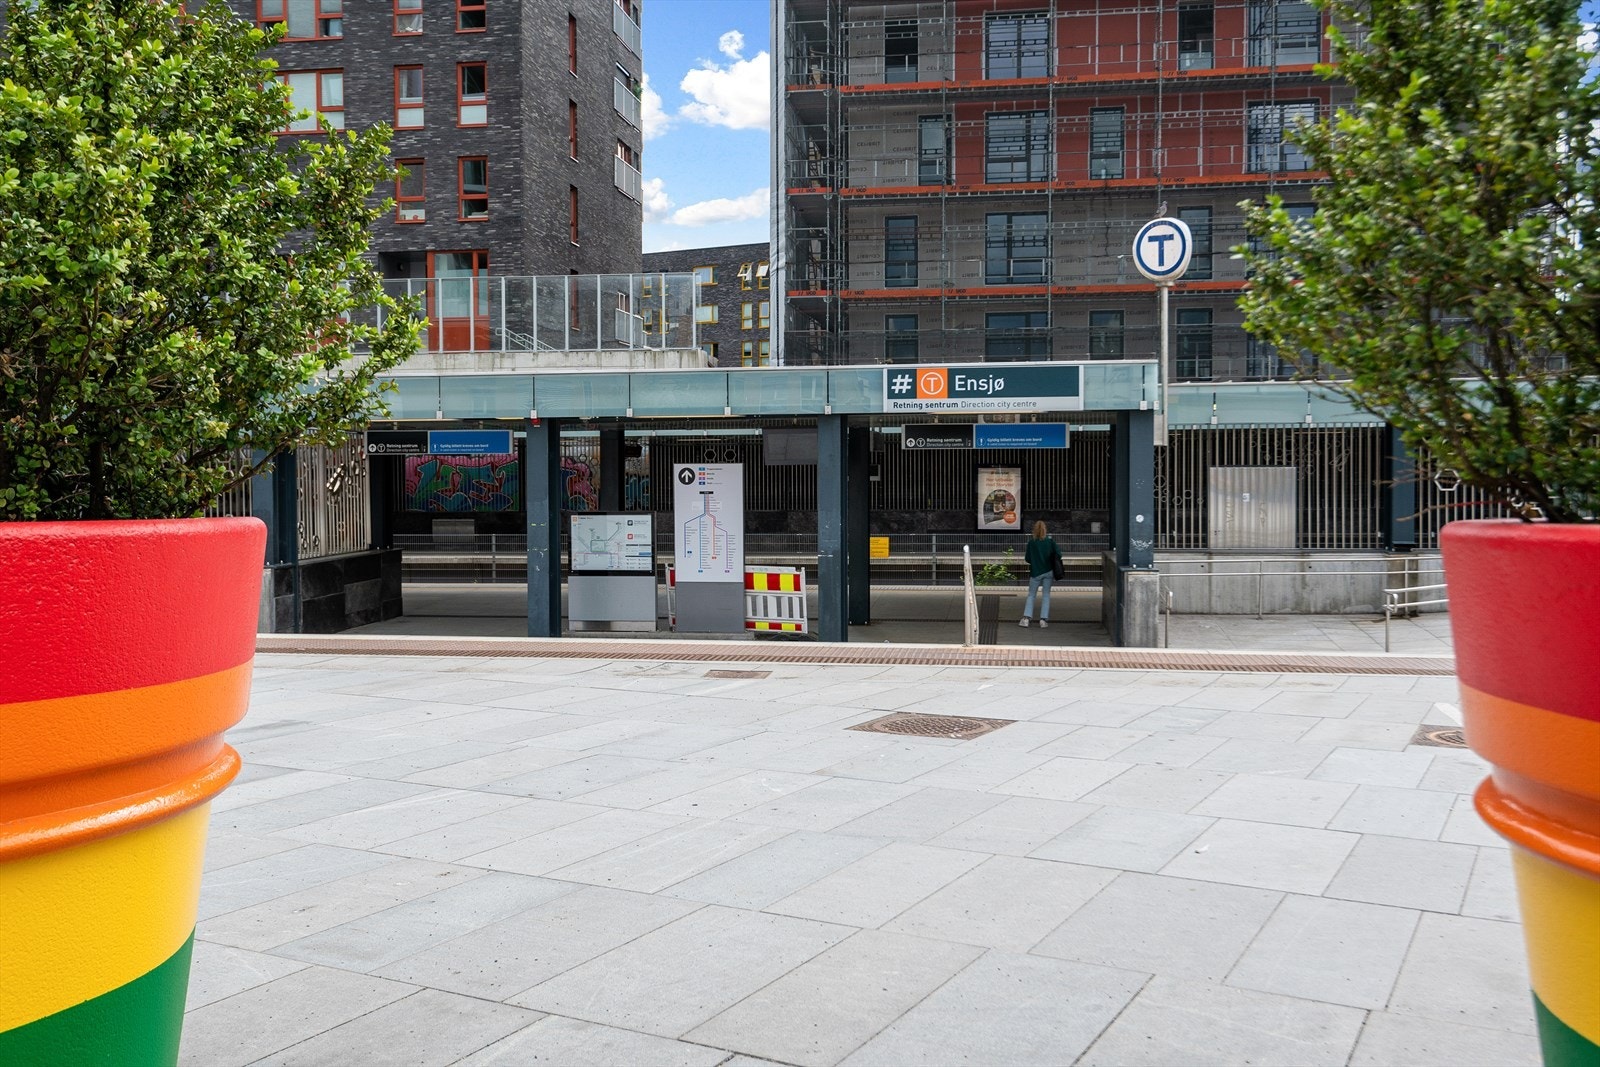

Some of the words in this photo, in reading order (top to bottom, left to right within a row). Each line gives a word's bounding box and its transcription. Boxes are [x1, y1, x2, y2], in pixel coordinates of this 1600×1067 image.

[1148, 234, 1174, 266] T
[955, 375, 1005, 394] Ensjø
[997, 400, 1010, 409] city
